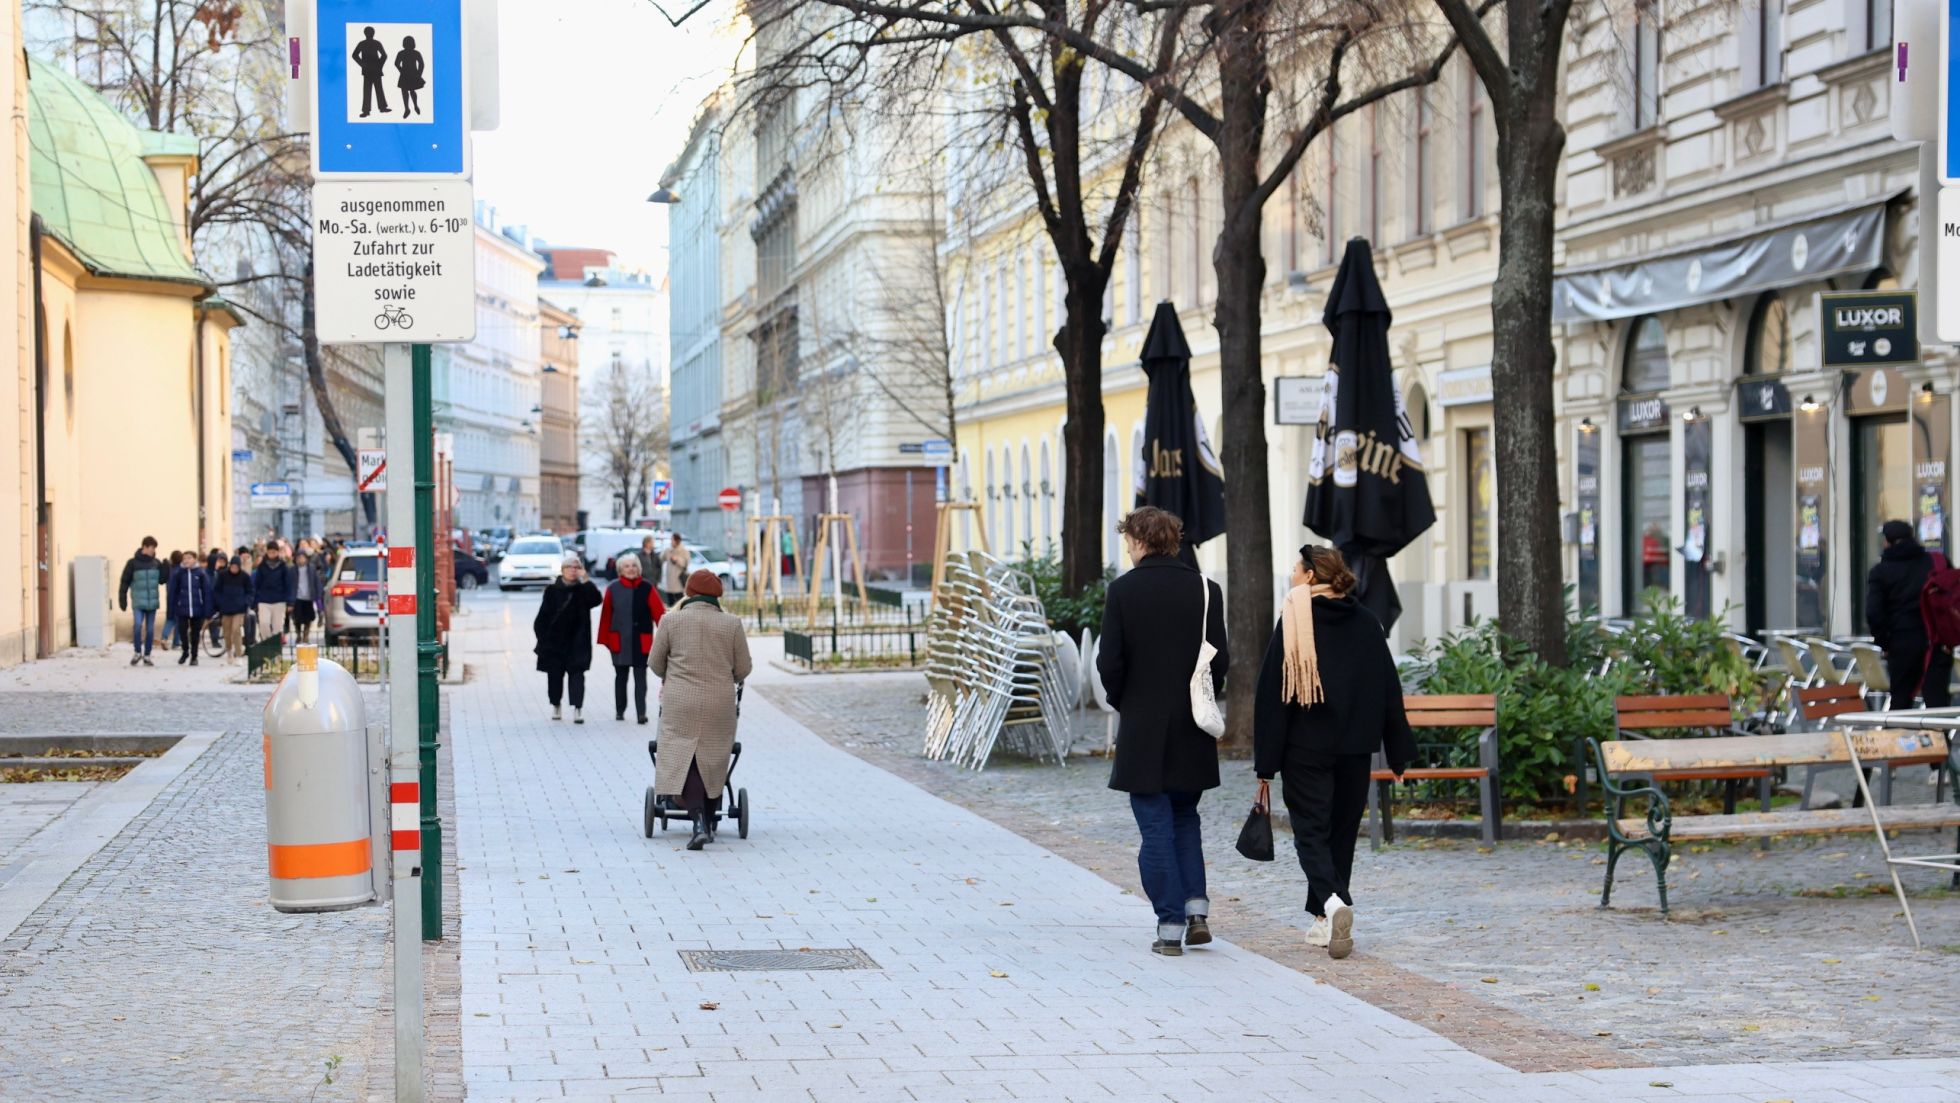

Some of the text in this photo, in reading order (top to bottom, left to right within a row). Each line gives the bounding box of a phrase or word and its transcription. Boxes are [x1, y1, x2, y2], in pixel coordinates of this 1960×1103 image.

[340, 200, 445, 216] ausgenommen
[319, 219, 371, 235] Mo.-Sa.
[376, 221, 416, 235] (werkt.)
[418, 225, 427, 234] v.
[353, 240, 435, 256] Zufahrt zur
[347, 260, 443, 280] Ladetätigkeit
[374, 284, 416, 300] sowie
[1837, 307, 1901, 327] LUXOR
[1631, 400, 1662, 421] LUXOR
[1799, 467, 1824, 482] LUXOR
[1916, 461, 1945, 479] LUXOR
[1687, 473, 1708, 488] LUXOR
